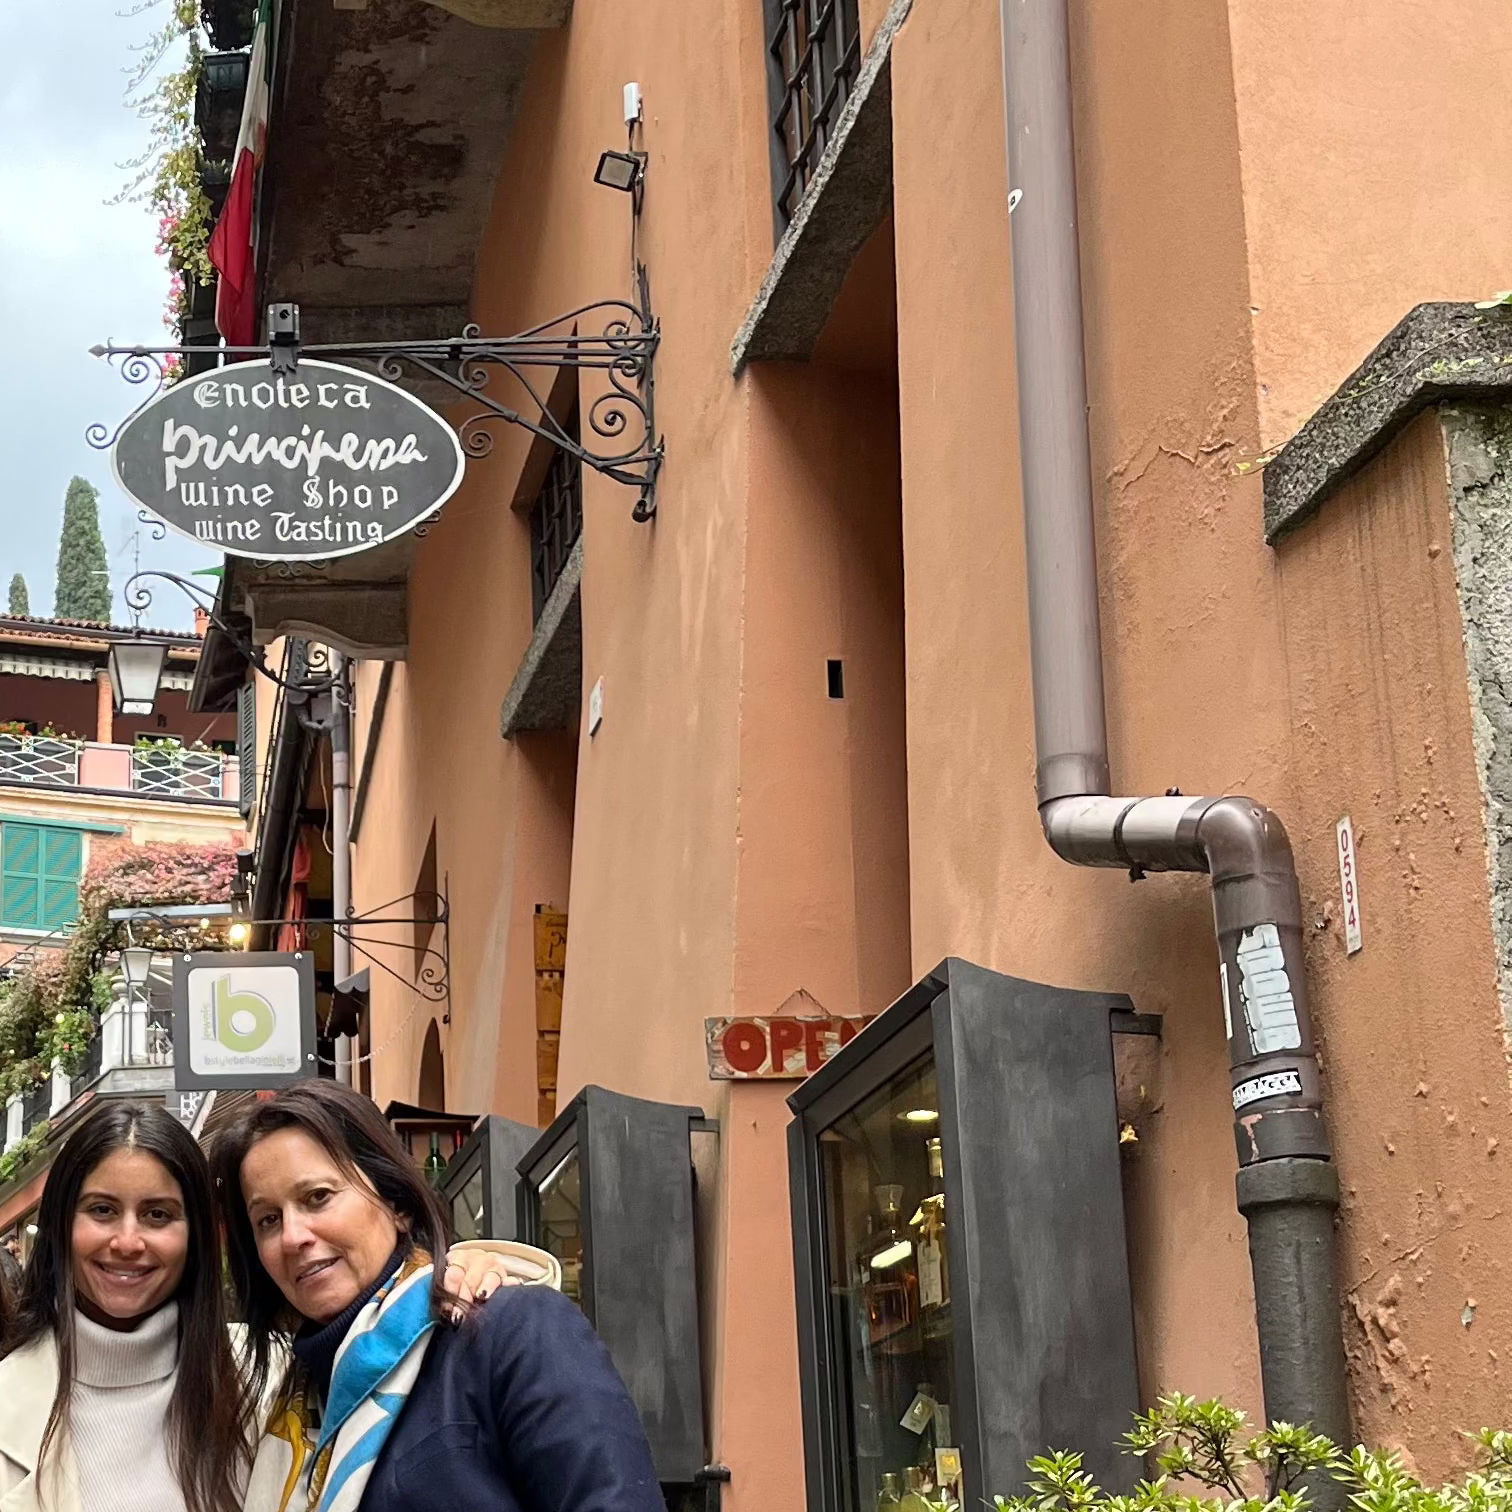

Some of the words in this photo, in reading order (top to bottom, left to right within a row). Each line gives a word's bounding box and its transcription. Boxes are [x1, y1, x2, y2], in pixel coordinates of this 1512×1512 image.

[193, 377, 371, 410] Enoteca
[302, 475, 399, 510] Shop
[270, 511, 385, 544] Tasting
[1340, 828, 1357, 929] 0594
